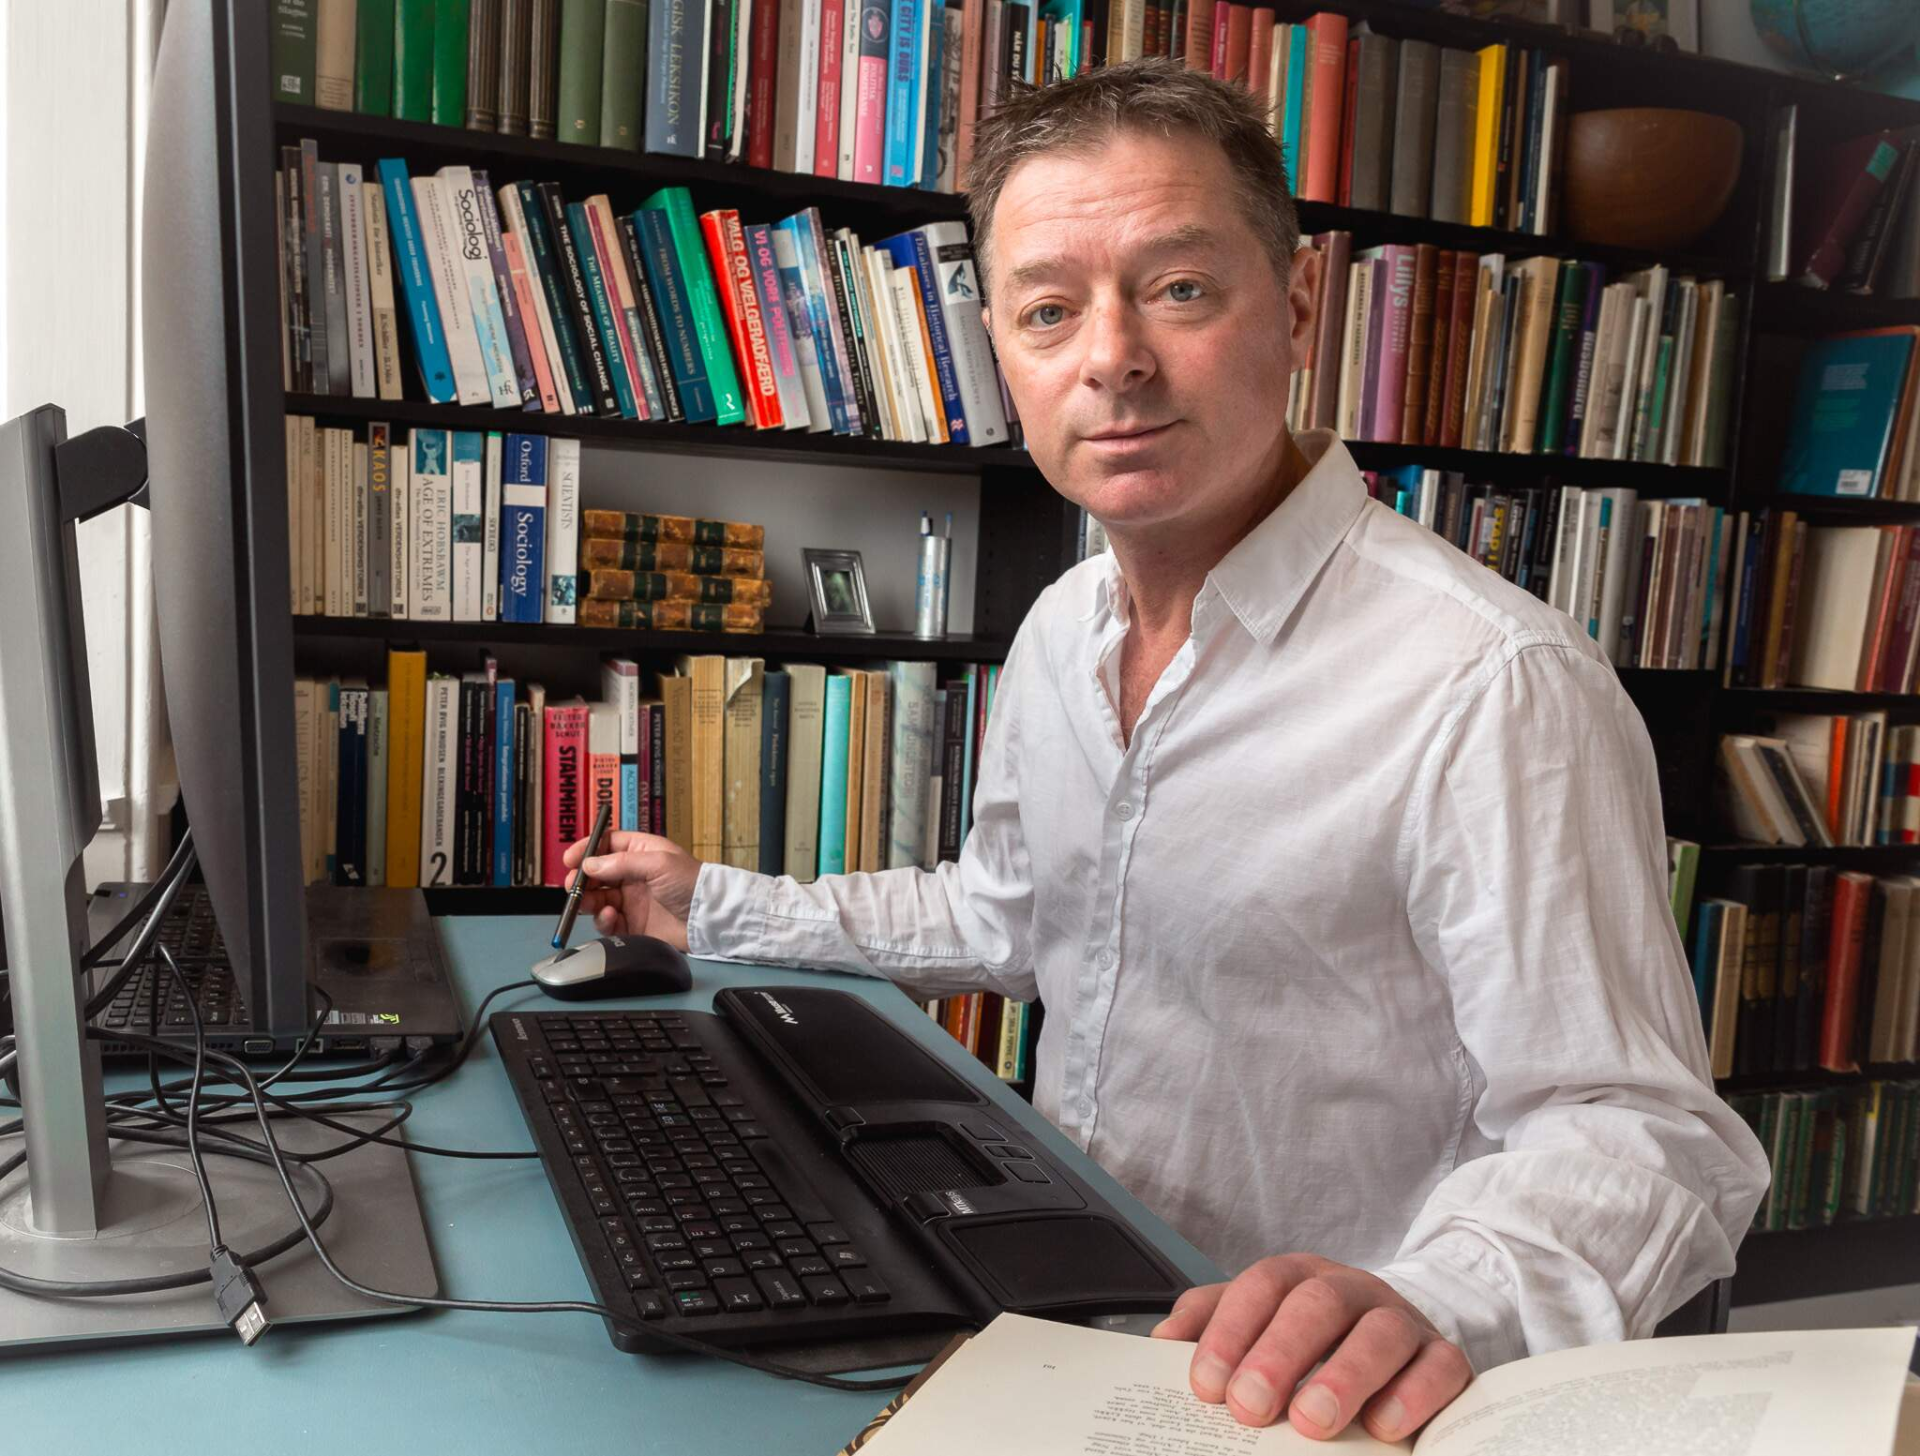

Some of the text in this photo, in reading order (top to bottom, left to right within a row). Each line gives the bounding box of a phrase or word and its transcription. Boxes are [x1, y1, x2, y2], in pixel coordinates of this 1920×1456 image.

[898, 6, 916, 32] CITY
[899, 36, 911, 48] IS
[1011, 31, 1023, 67] NÅR DU
[665, 43, 684, 125] LEKSIKON
[896, 51, 912, 82] OURS
[450, 187, 487, 262] Sociologi
[482, 184, 502, 252] Videnskabsteori
[558, 224, 570, 244] THE
[753, 230, 767, 245] VI
[563, 244, 585, 299] SOCIOLOGY
[585, 254, 598, 274] THE
[757, 246, 772, 267] OG
[590, 274, 609, 315] MEASURE
[761, 268, 780, 303] VORE
[1387, 253, 1417, 308] Lillys
[578, 299, 589, 313] OF
[658, 247, 695, 375] FROM WORDS TO NUMBERS
[724, 216, 777, 397] VALG OG VÆLGERADFÆRD
[825, 238, 865, 405] BURKE HISTORY AND SOCIAL THEORY
[912, 236, 960, 401] Databases in Historical Research
[582, 313, 599, 350] SOCIAL
[604, 328, 622, 364] REALITY
[591, 350, 610, 392] CHANGE
[372, 450, 386, 492] KAOS
[519, 440, 532, 482] Oxford
[560, 471, 573, 529] SCIENTISTS
[419, 477, 435, 601] AGE OF EXTREMES
[435, 488, 446, 591] ERIC HOBSBAWM
[487, 517, 496, 552] SOCIOLOGY
[509, 511, 533, 596] Sociology
[356, 519, 364, 597] VERDENSHISTORIEN
[393, 522, 402, 597] VERDENSHISTORIEN
[357, 691, 366, 734] Politikens
[653, 713, 661, 736] PETER
[372, 717, 381, 756] Nietzsche
[434, 686, 447, 846] PETER ØVIG KNUDSEN BLEKINGEGADEBANDEN
[553, 745, 580, 843] STAMMHEIM
[639, 781, 648, 802] OM
[430, 852, 447, 886] 2
